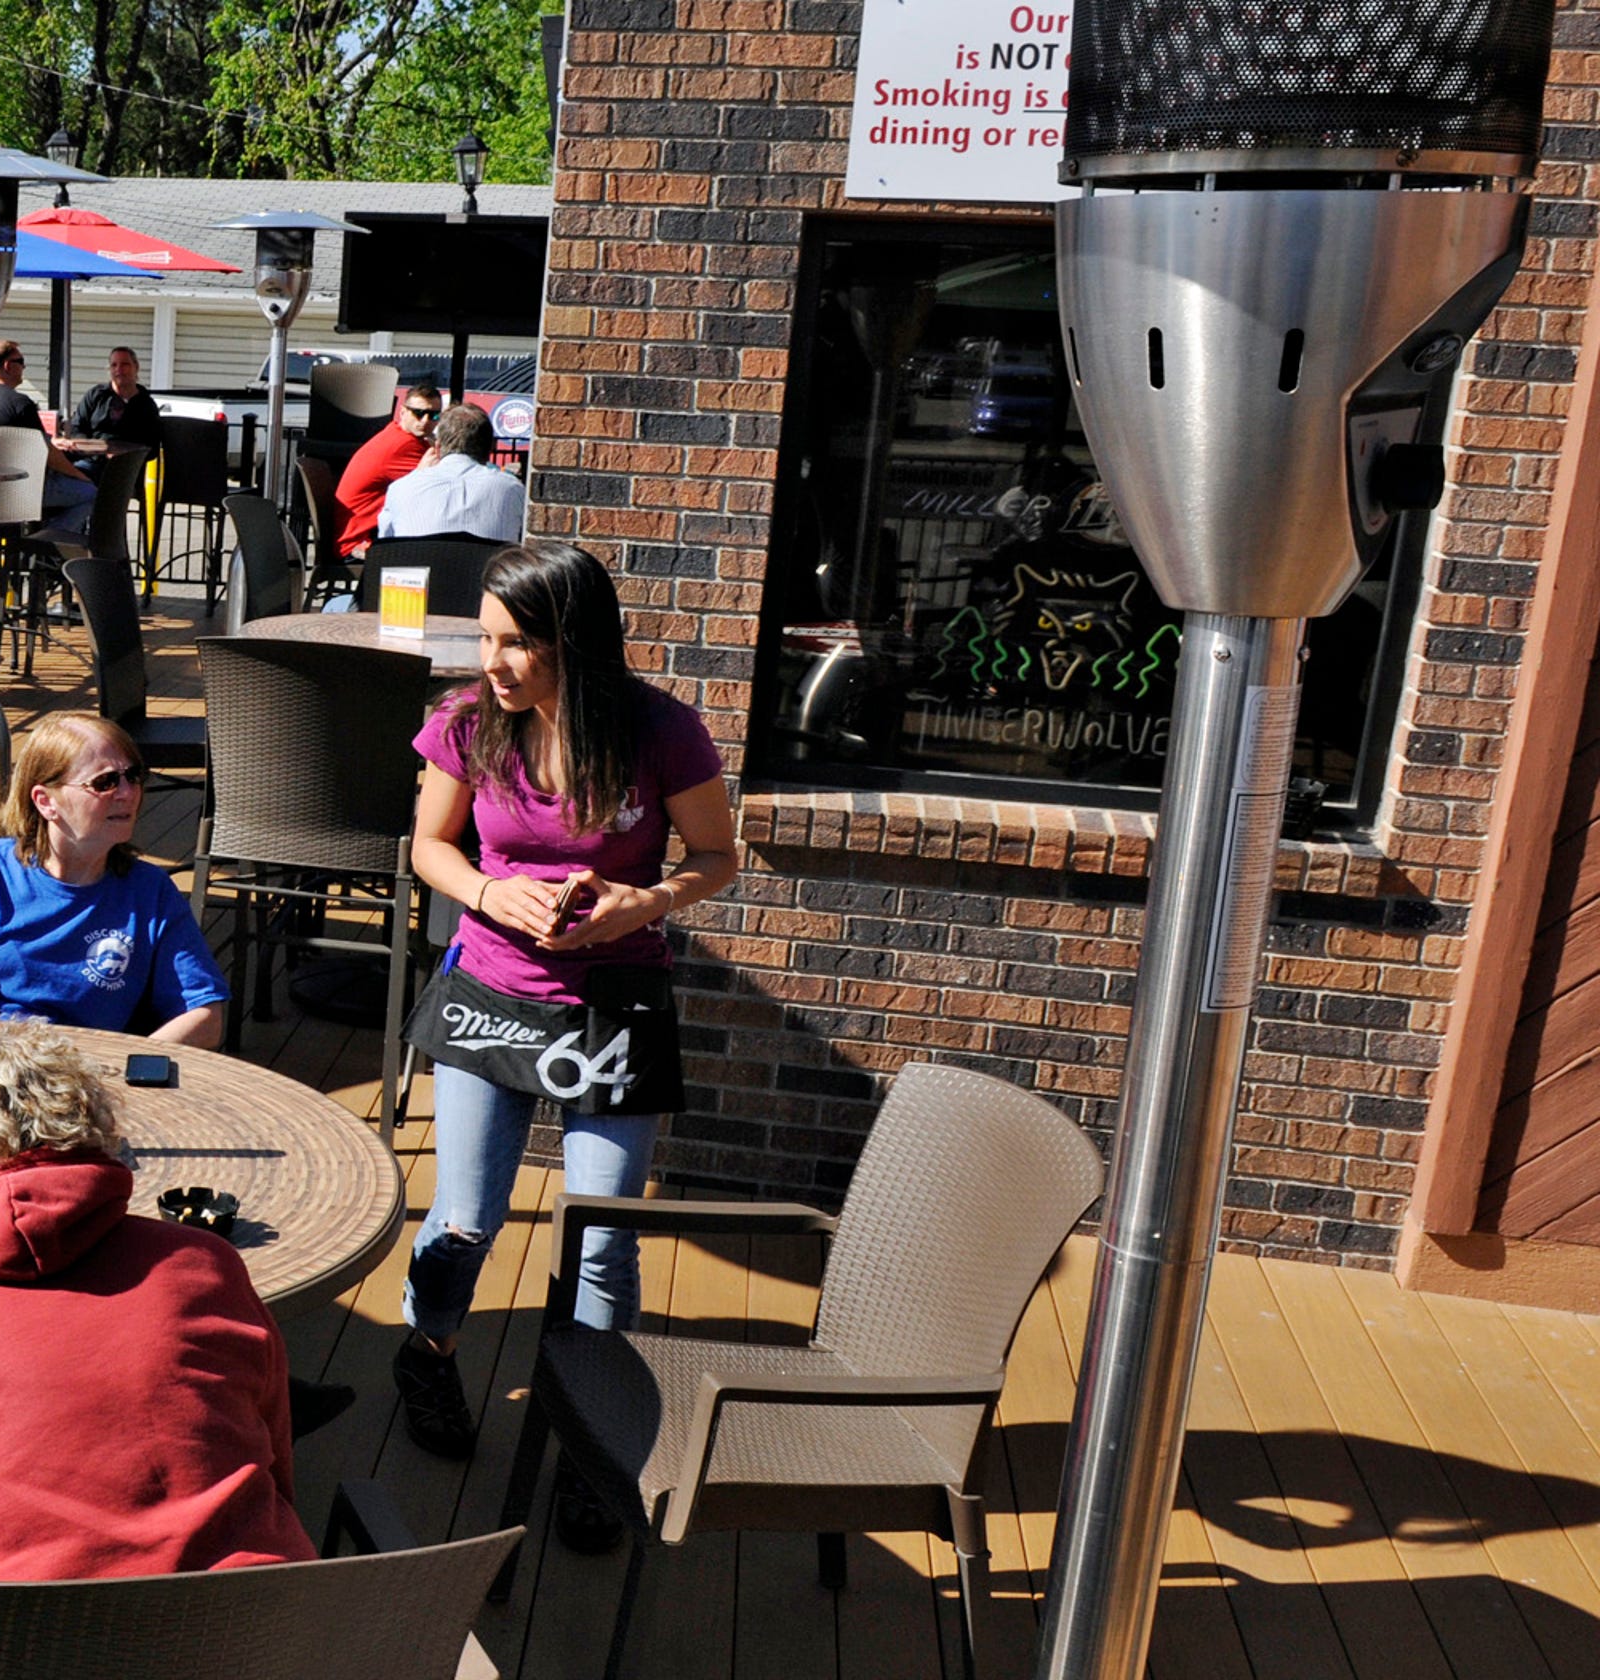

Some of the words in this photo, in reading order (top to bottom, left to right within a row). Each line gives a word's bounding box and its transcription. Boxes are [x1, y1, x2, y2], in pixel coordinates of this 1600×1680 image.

[1010, 6, 1069, 33] Our
[956, 44, 980, 69] is
[990, 43, 1059, 70] NOT
[874, 79, 1011, 115] Smoking
[1024, 82, 1049, 108] is
[869, 117, 971, 153] dining
[983, 127, 1016, 146] or
[443, 1003, 547, 1043] Miller
[536, 1027, 636, 1105] 64
